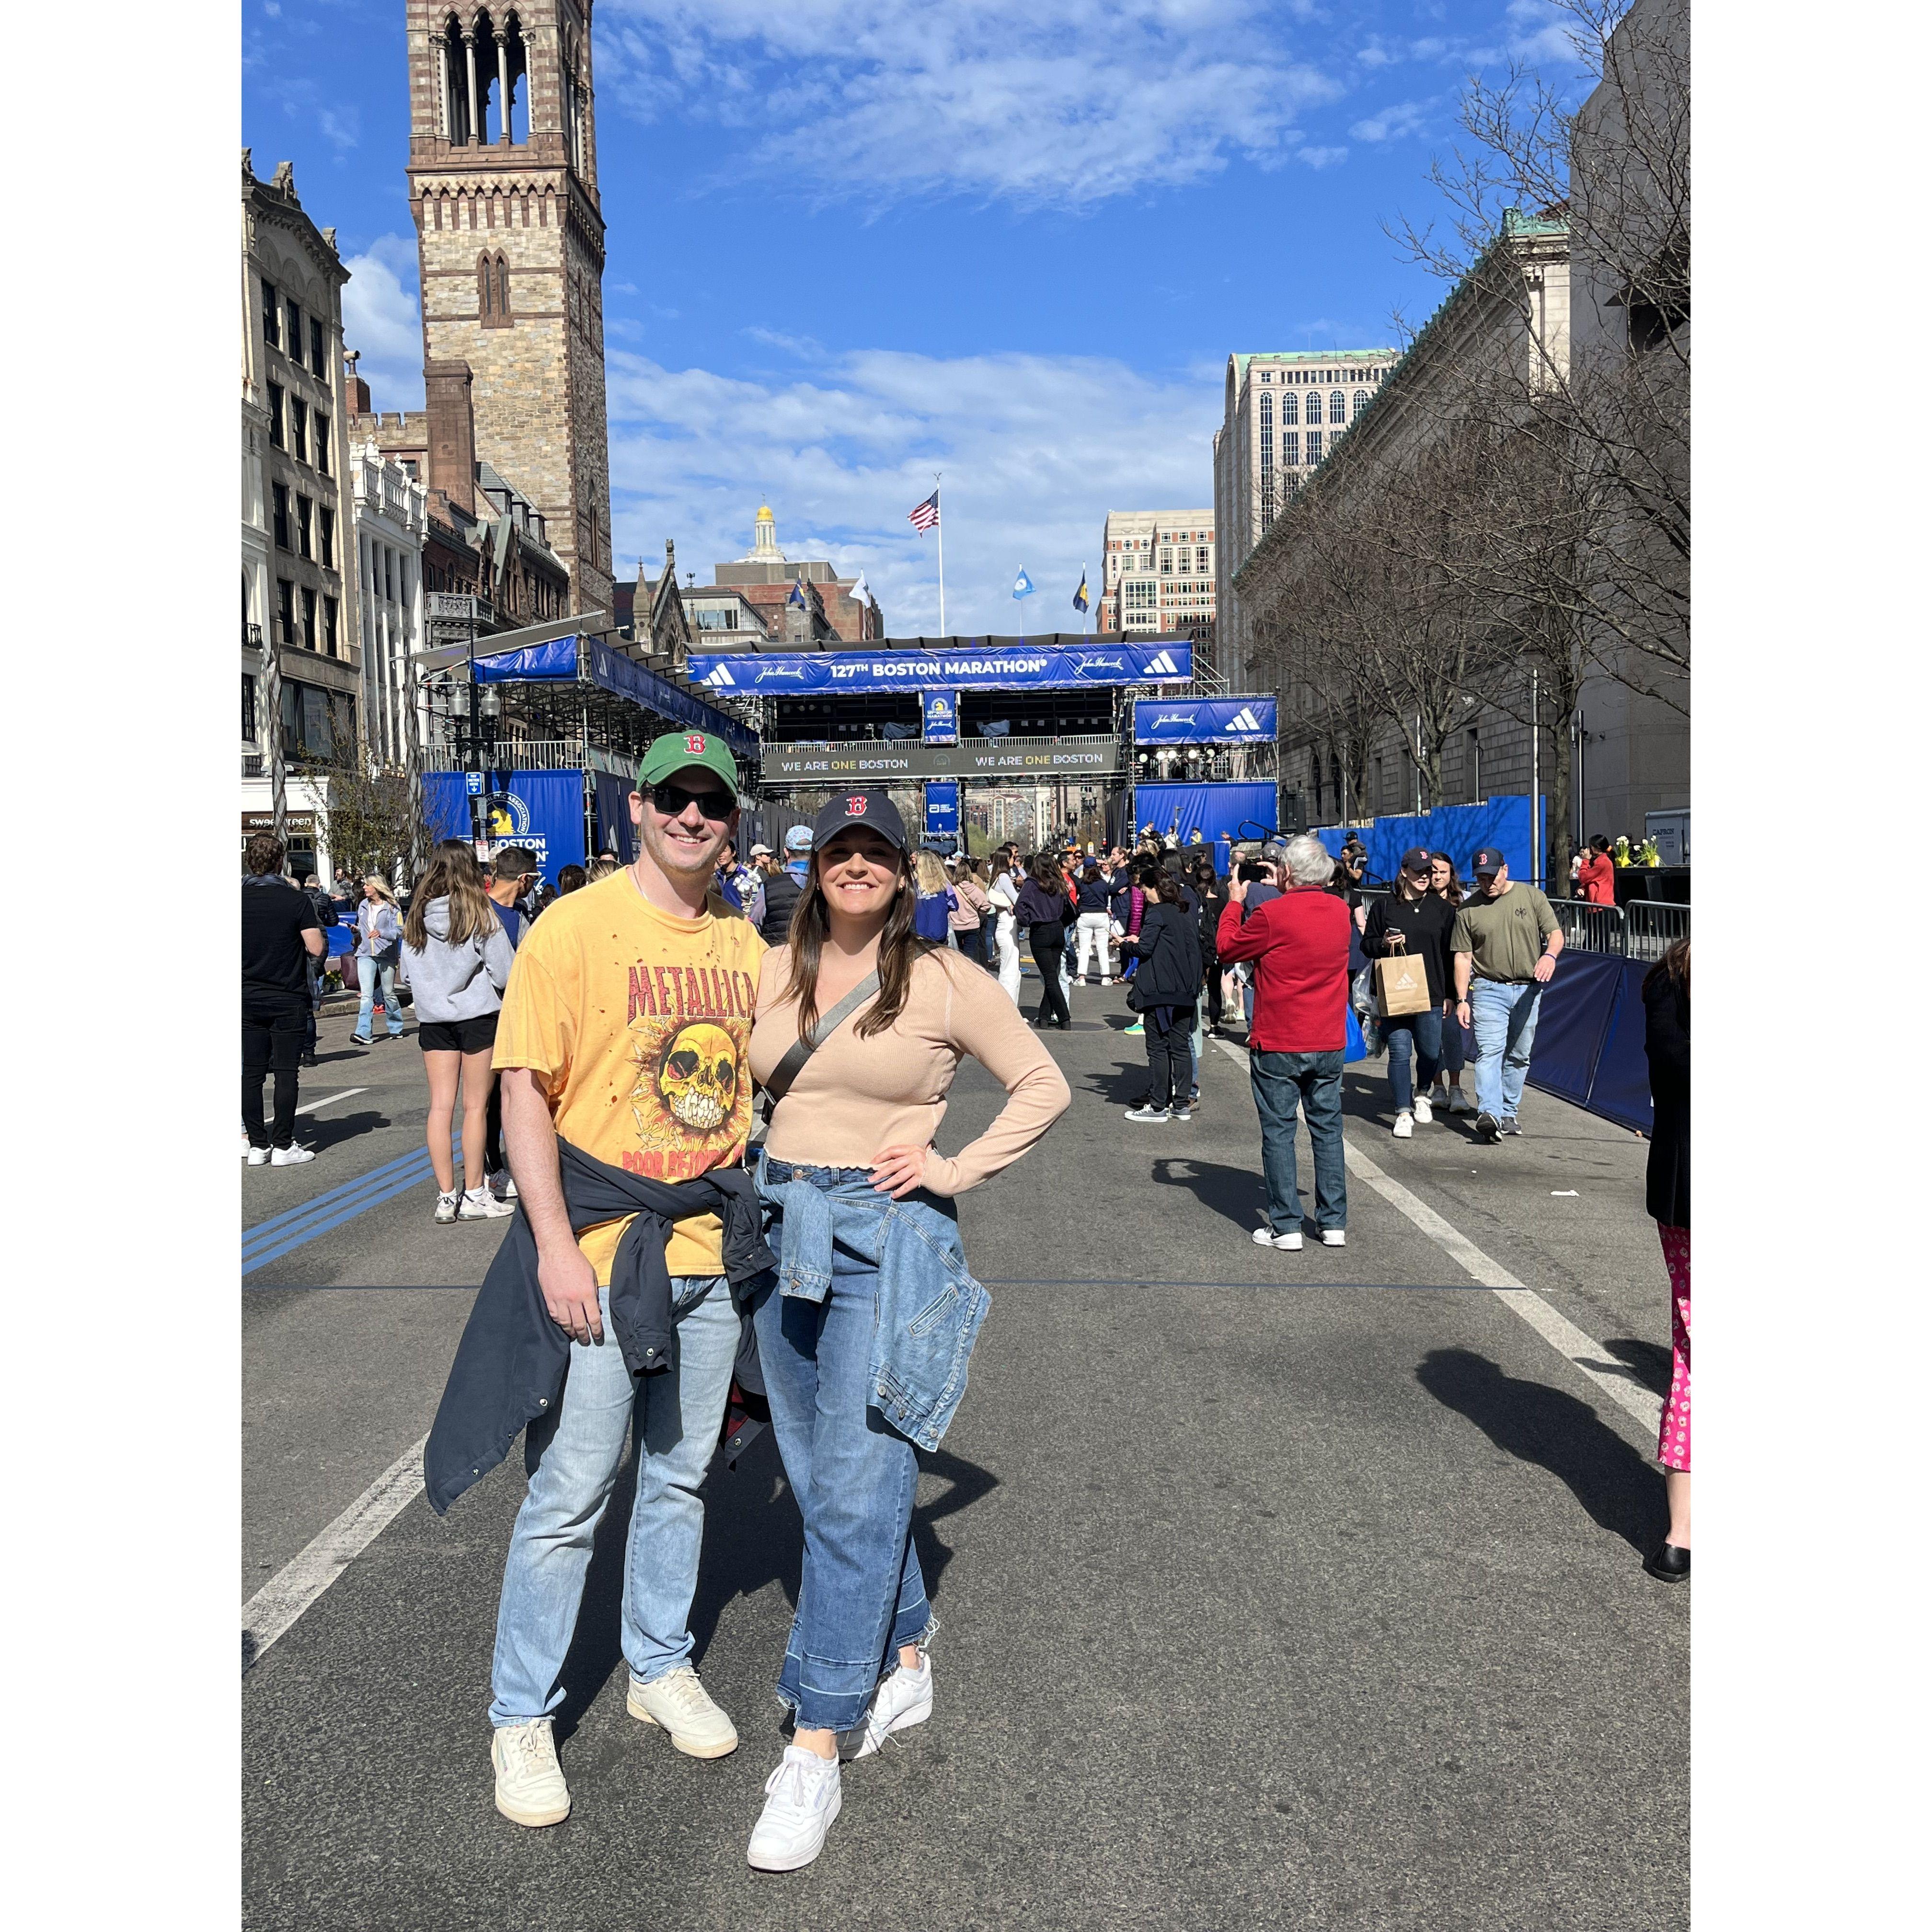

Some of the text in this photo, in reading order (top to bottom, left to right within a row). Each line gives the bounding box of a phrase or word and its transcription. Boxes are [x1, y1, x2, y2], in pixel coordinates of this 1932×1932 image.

[830, 664, 868, 678] 127TH
[873, 663, 940, 677] BOSTON
[683, 734, 706, 754] B
[782, 759, 908, 771] WE ARE ONE BOSTON
[975, 754, 1103, 766] WE ARE ONE BOSTON
[508, 795, 528, 832] ASSOCIATION
[845, 796, 868, 816] B
[490, 838, 546, 850] BOSTON
[627, 966, 755, 1026] METALLICA
[622, 1150, 664, 1178] POOR
